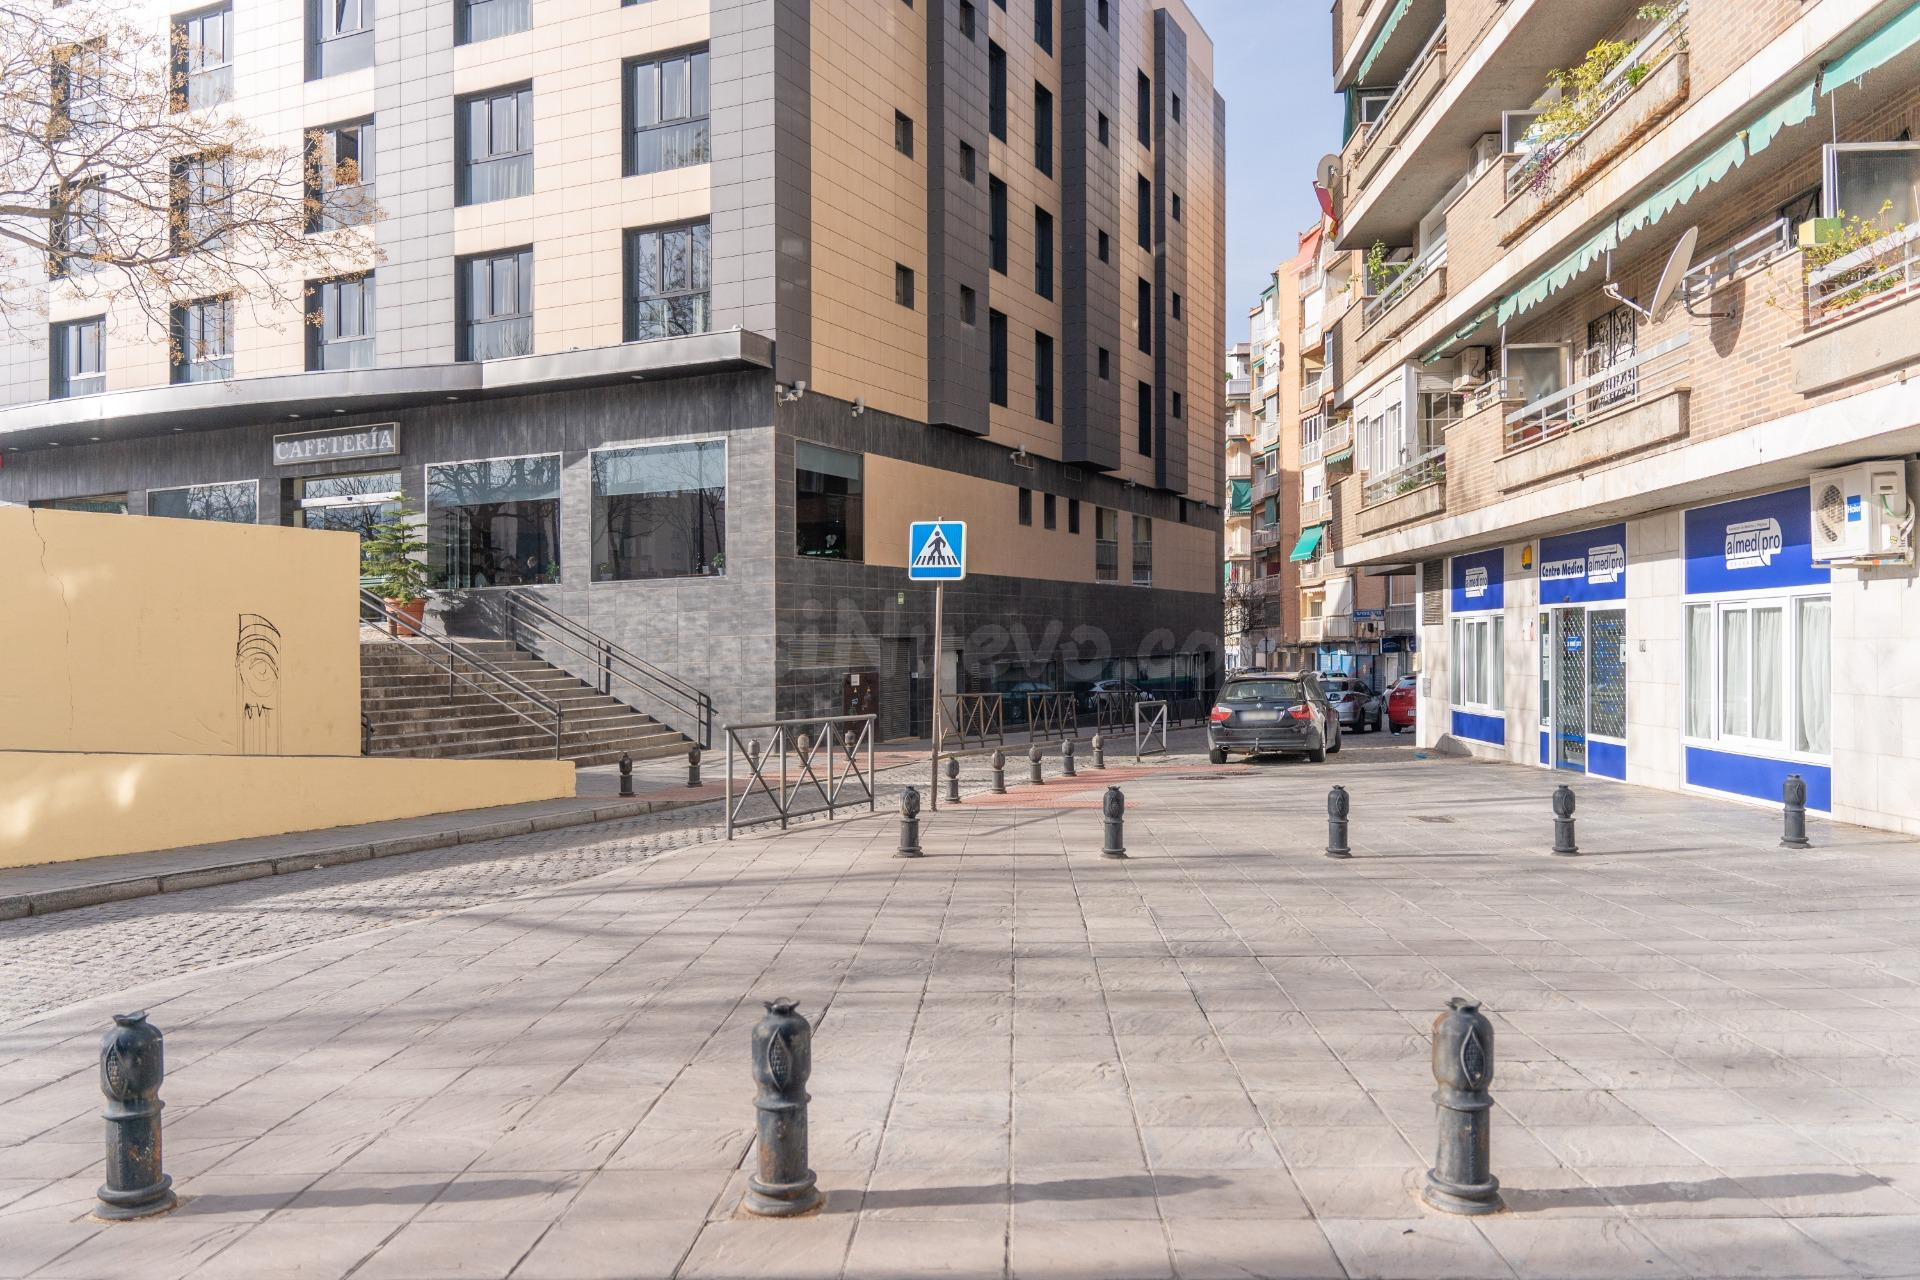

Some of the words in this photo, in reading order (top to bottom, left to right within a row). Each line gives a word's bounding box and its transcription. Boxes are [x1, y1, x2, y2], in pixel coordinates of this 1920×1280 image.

[276, 427, 394, 460] CAFETERÍA
[1542, 565, 1560, 577] Centro
[1562, 560, 1584, 576] Médico
